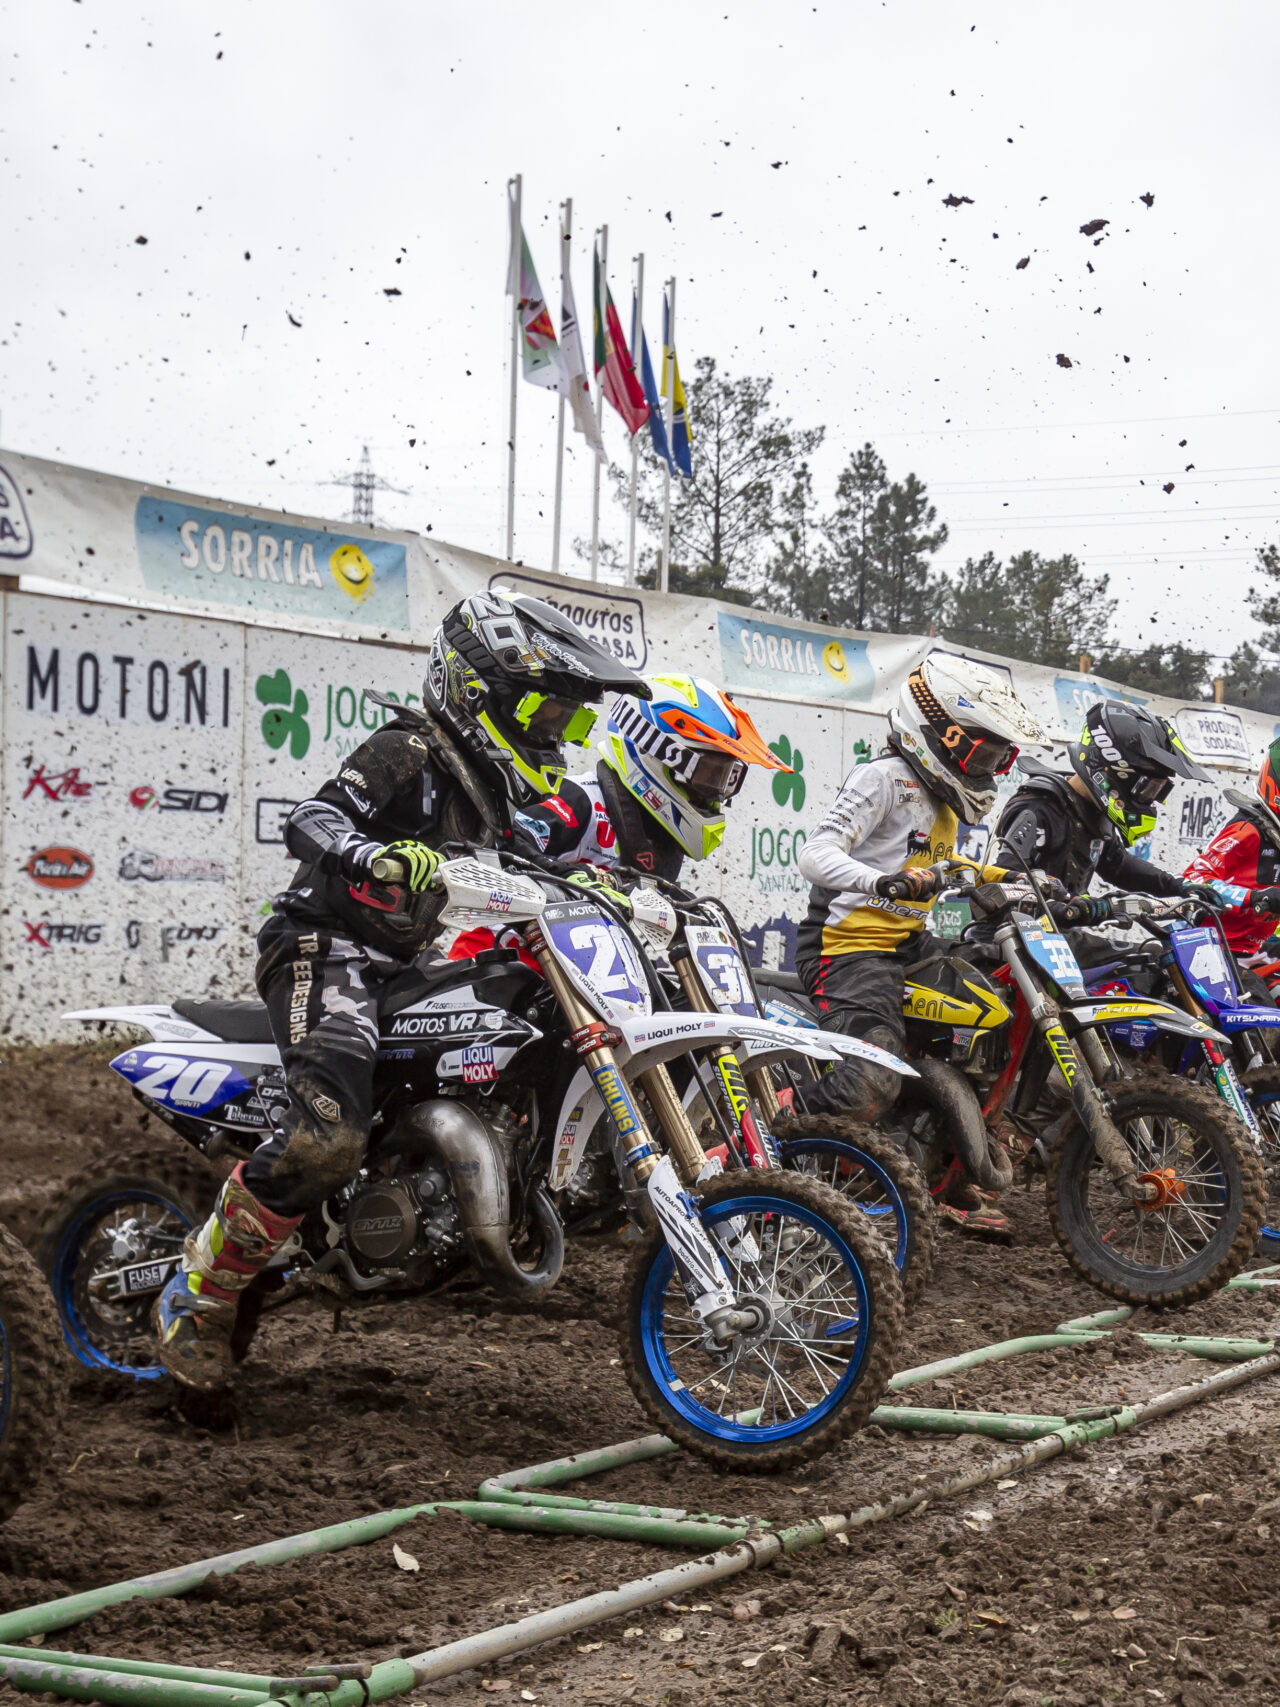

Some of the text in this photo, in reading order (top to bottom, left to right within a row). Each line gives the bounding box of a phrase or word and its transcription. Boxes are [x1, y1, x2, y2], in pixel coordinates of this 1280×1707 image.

[178, 517, 324, 589] SORRIA
[551, 600, 634, 636] RODUTOS
[739, 627, 821, 677] SORRIA
[26, 645, 230, 728] MOTONI
[486, 901, 511, 912] MOLY
[489, 891, 513, 902] LIQUI
[577, 974, 609, 1011] LIQUI MOLY
[771, 999, 806, 1017] MICHELIN
[914, 1001, 943, 1020] eni
[391, 1012, 477, 1035] MOTOS VR
[647, 1021, 703, 1041] LIQUI MOLY
[463, 1047, 493, 1064] LIQUI
[134, 1055, 233, 1105] 20
[463, 1064, 494, 1083] MOLY
[595, 1068, 635, 1134] ÖHLINS
[712, 1065, 743, 1138] SUSPENSION
[223, 1103, 265, 1123] Taberna
[128, 1265, 160, 1285] FUSE
